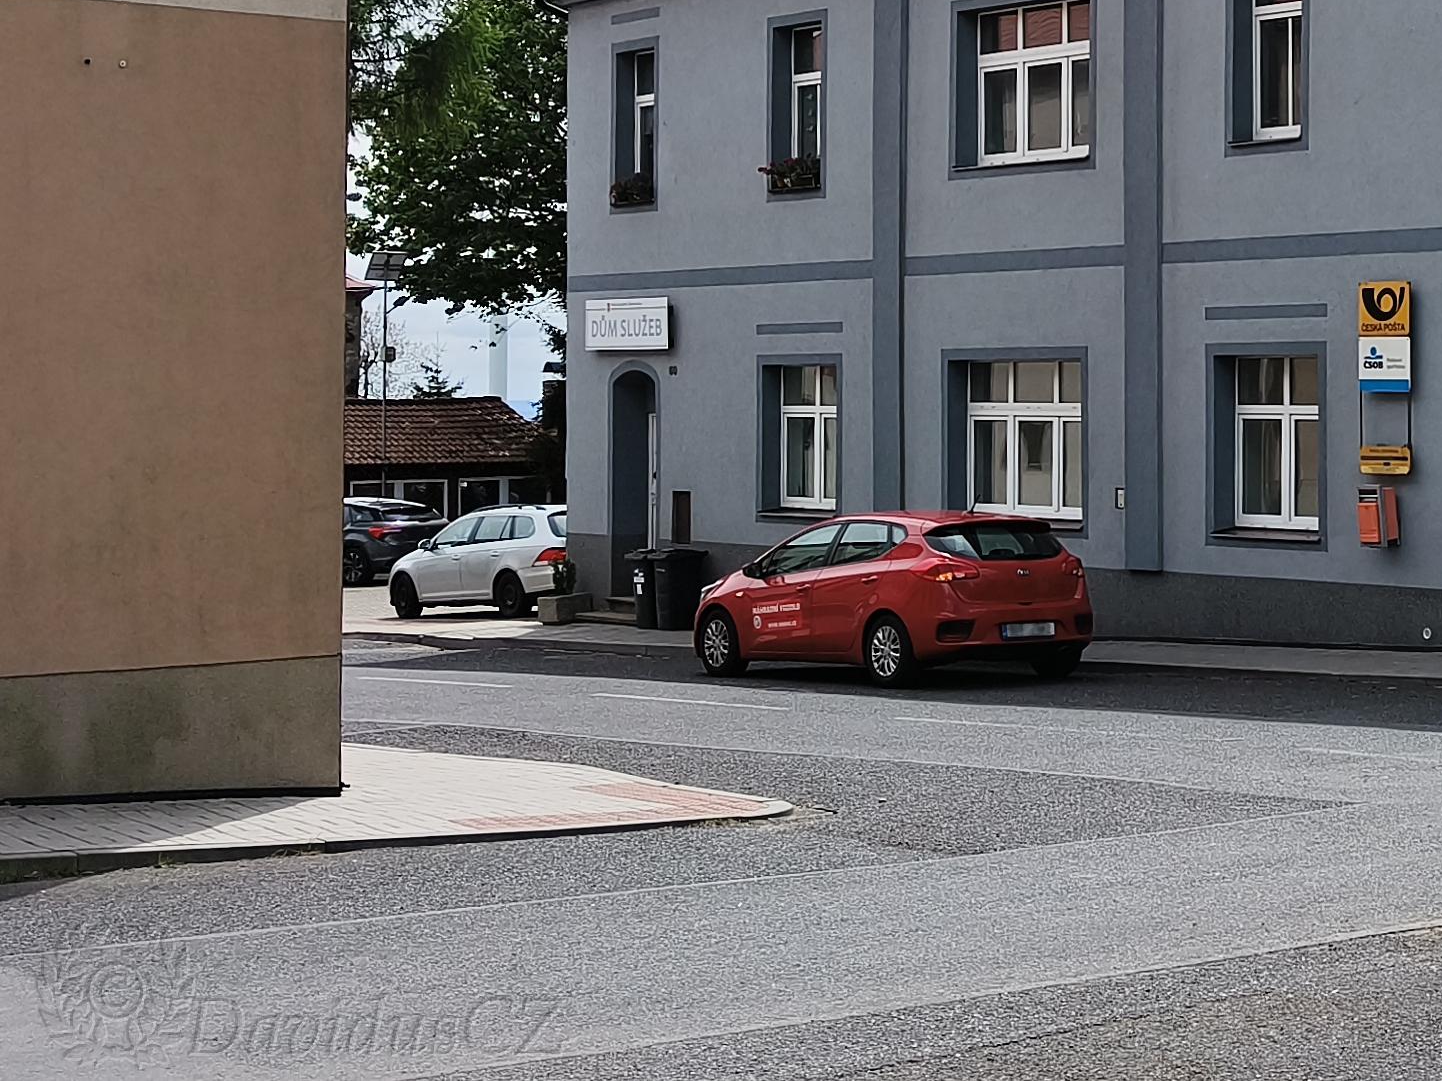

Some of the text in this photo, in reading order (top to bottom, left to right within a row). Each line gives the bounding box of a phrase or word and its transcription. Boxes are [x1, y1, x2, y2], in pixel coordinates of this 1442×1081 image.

[591, 314, 662, 338] DŮM SLUŽEB
[1361, 321, 1406, 332] ČESKÁ POŠTA
[1363, 360, 1384, 369] ČSOB
